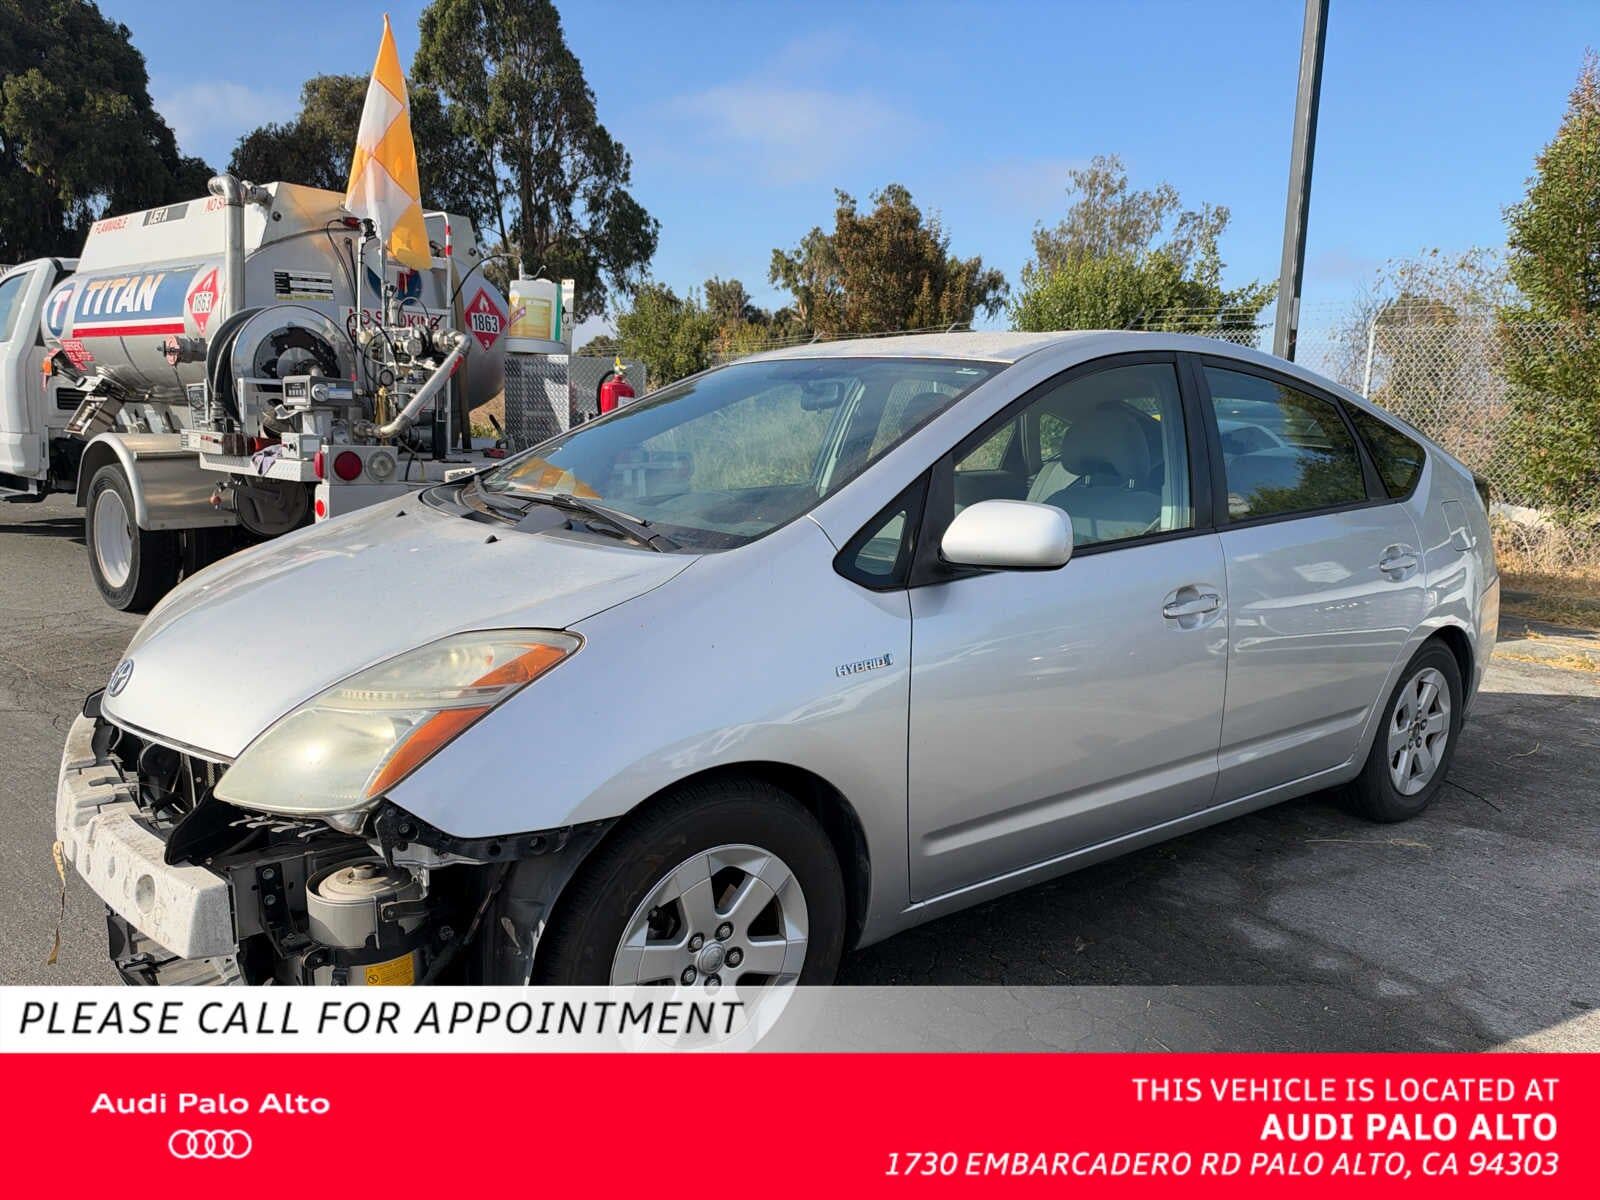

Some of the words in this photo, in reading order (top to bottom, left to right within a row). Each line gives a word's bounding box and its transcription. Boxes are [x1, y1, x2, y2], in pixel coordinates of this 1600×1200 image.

[82, 273, 166, 316] TITAN
[375, 311, 440, 331] SOKING
[473, 314, 498, 332] 1863
[835, 656, 886, 677] HYBRID
